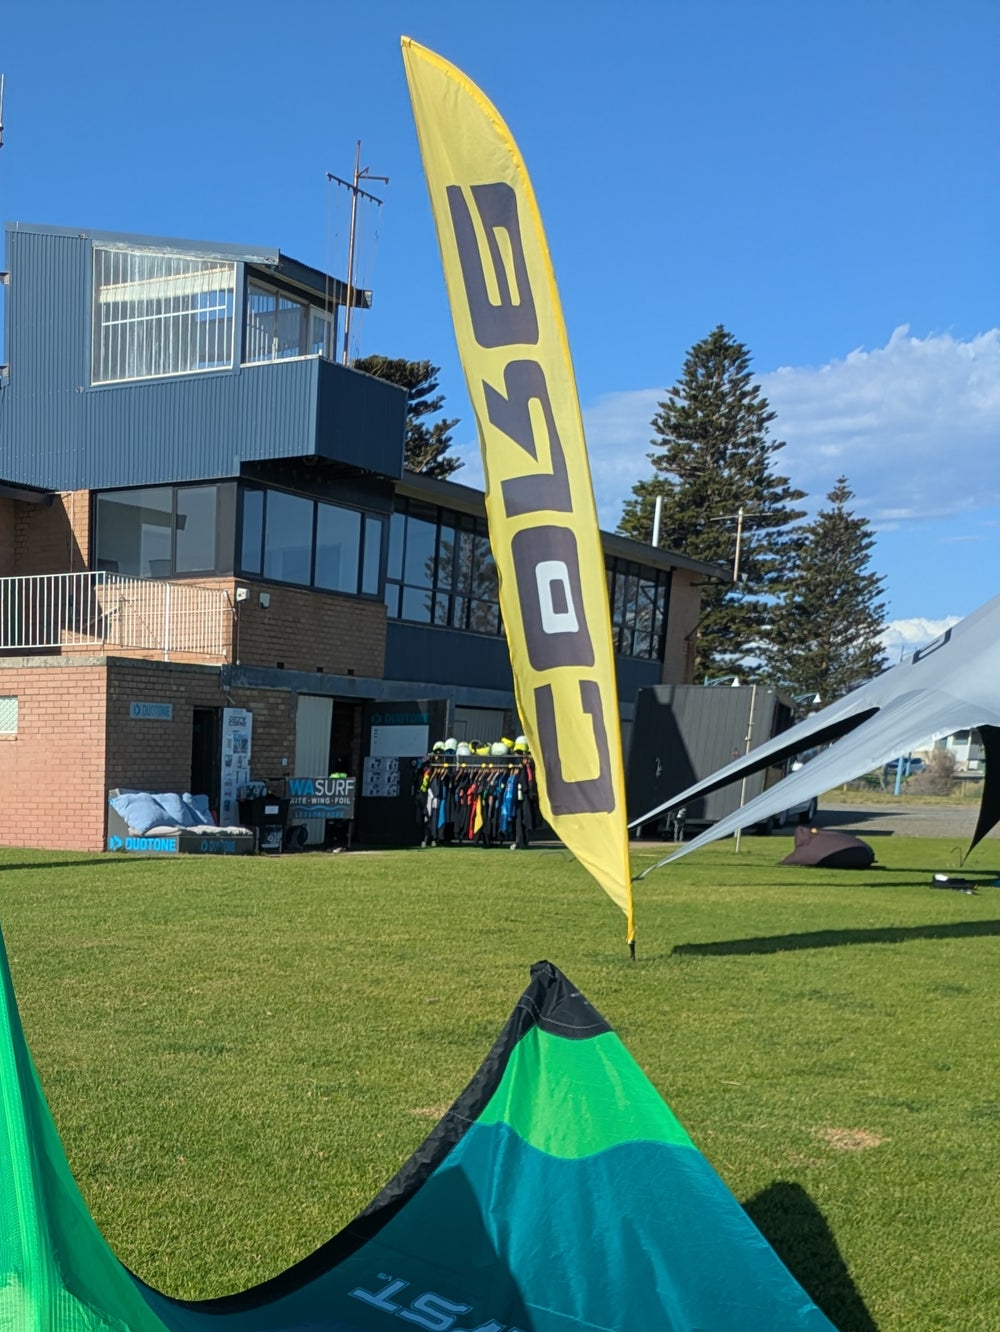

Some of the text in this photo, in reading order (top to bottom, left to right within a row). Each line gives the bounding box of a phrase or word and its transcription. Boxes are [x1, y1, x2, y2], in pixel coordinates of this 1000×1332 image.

[289, 779, 354, 796] WASURF
[311, 797, 331, 805] WING
[334, 797, 351, 805] FOIL
[125, 837, 176, 851] DUOTONE
